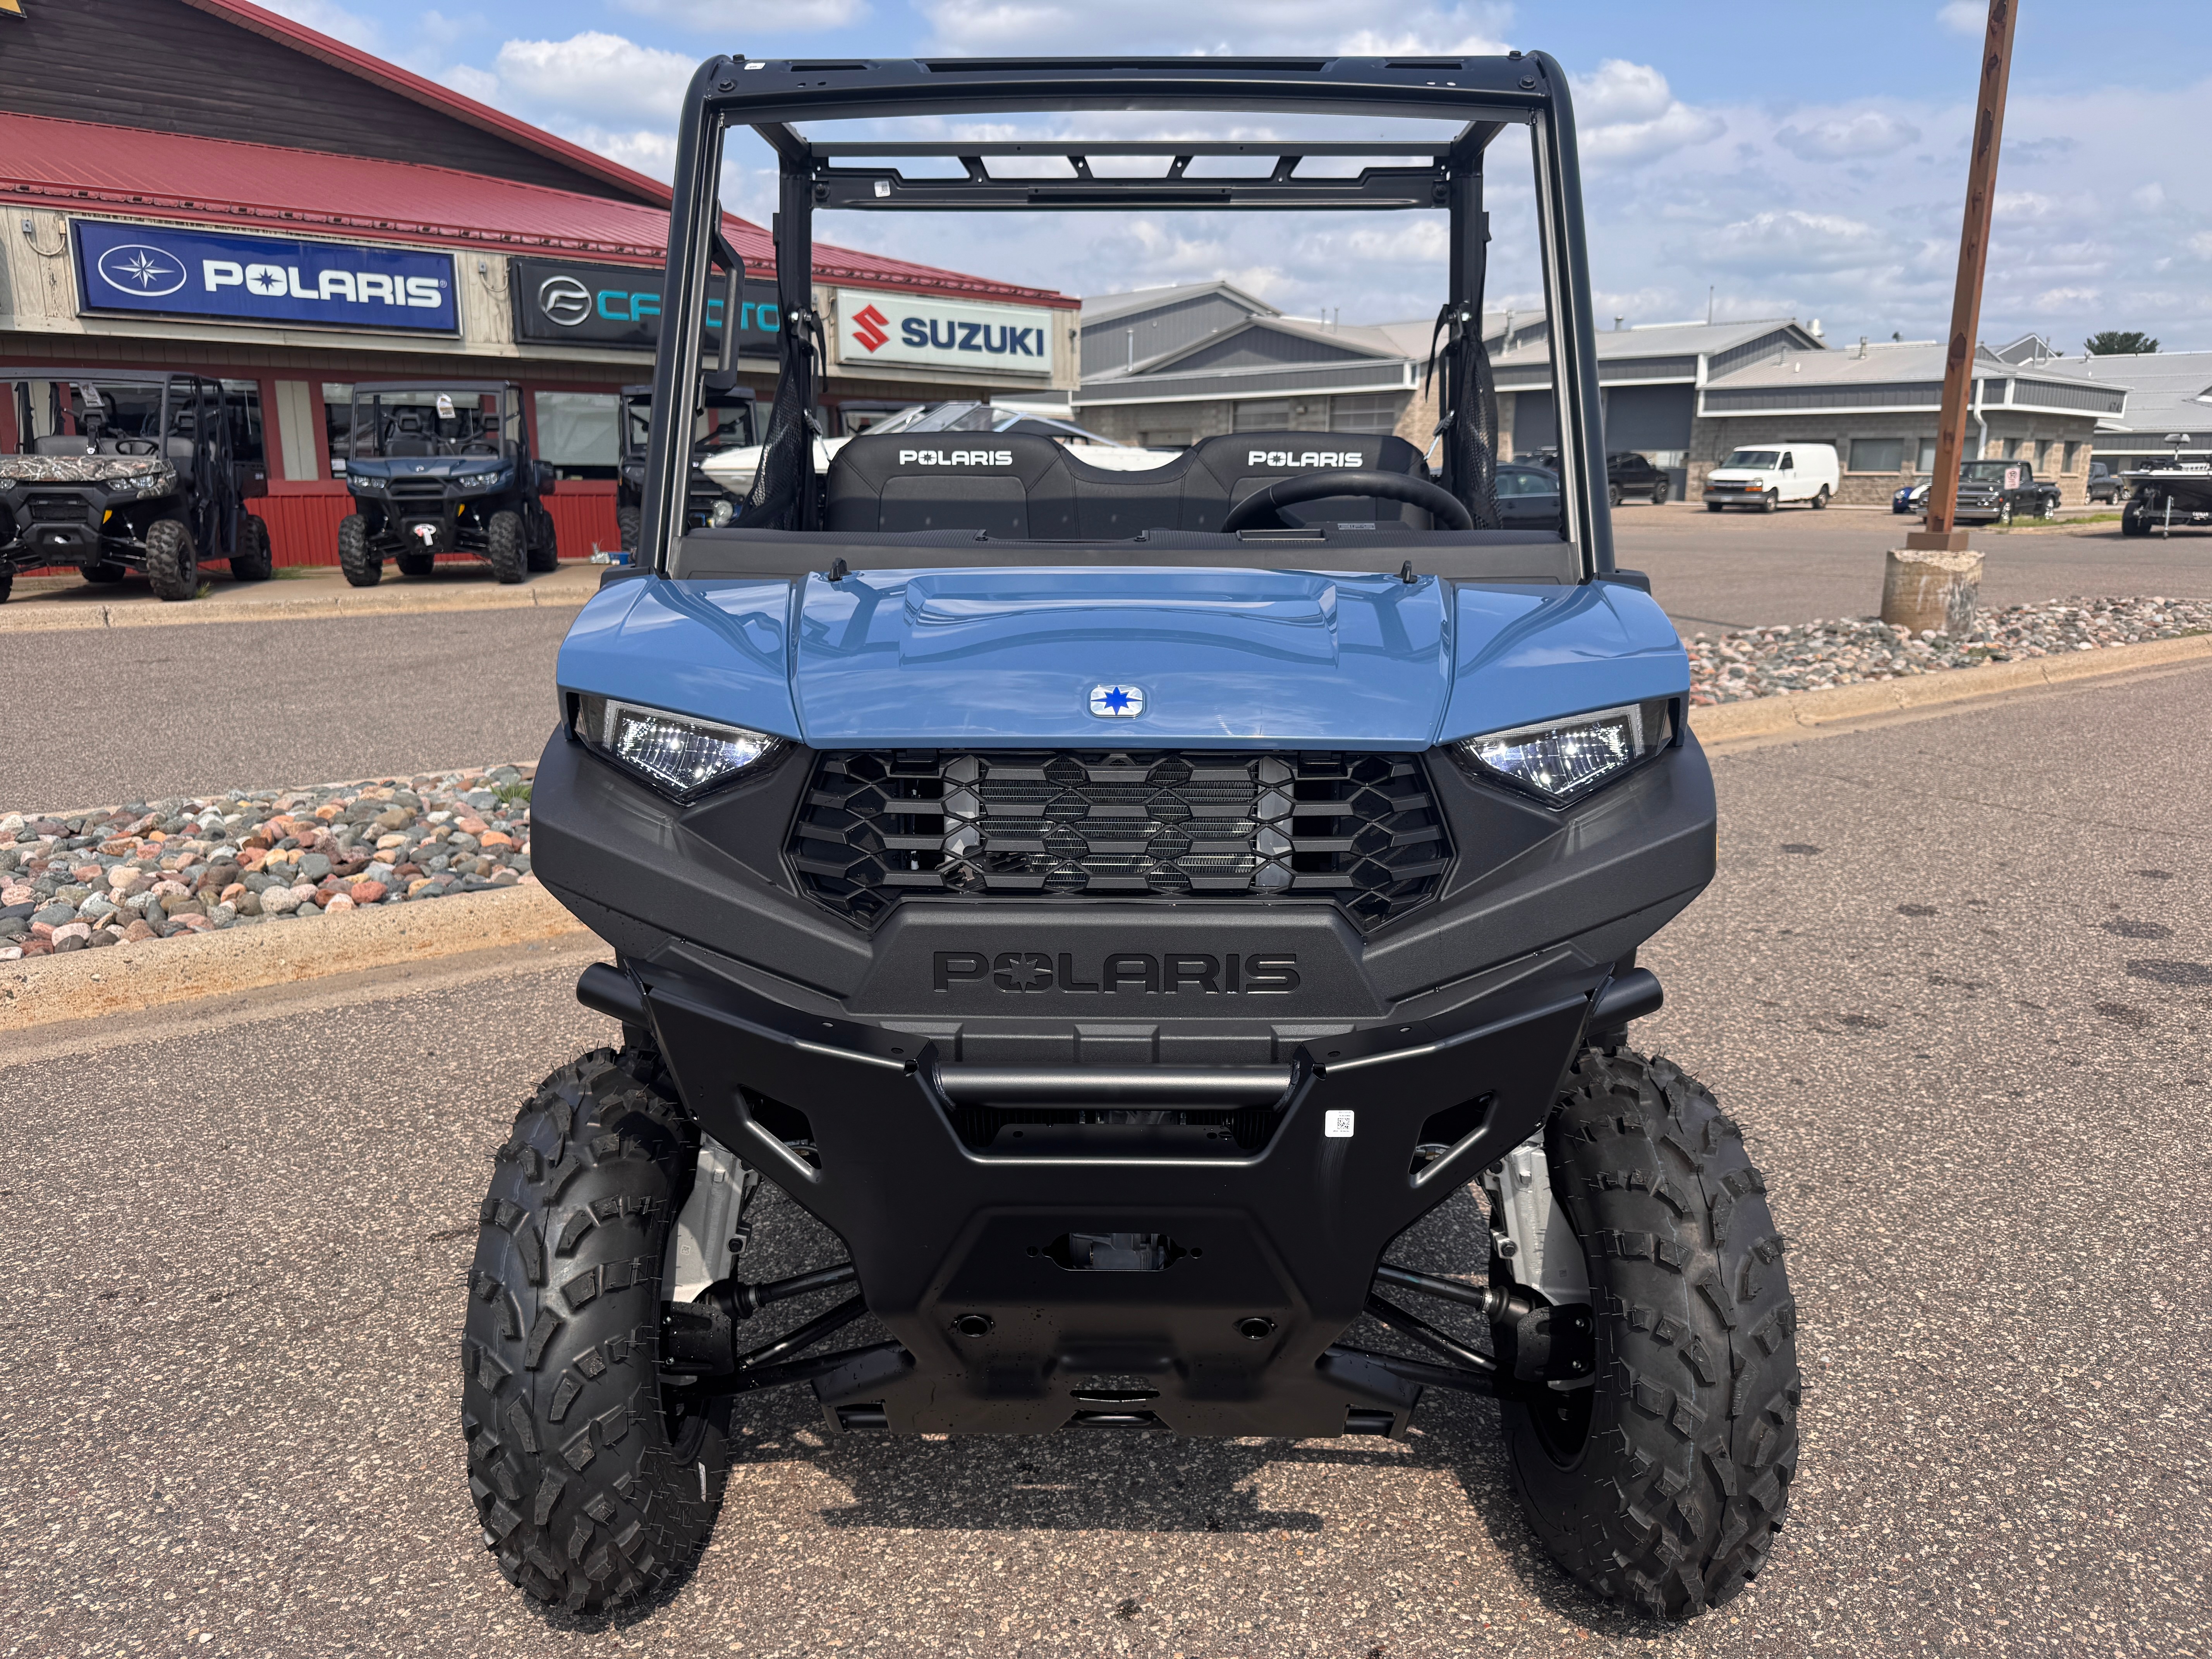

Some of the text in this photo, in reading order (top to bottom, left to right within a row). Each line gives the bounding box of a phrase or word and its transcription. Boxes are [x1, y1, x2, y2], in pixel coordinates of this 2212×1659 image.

[203, 259, 442, 308] POLARIS
[597, 289, 780, 332] CFOTO
[902, 318, 1044, 357] SUZUKI
[899, 450, 1013, 466] POLARIS
[1248, 450, 1363, 467] POLARIS
[933, 951, 1300, 994] POLARIS
